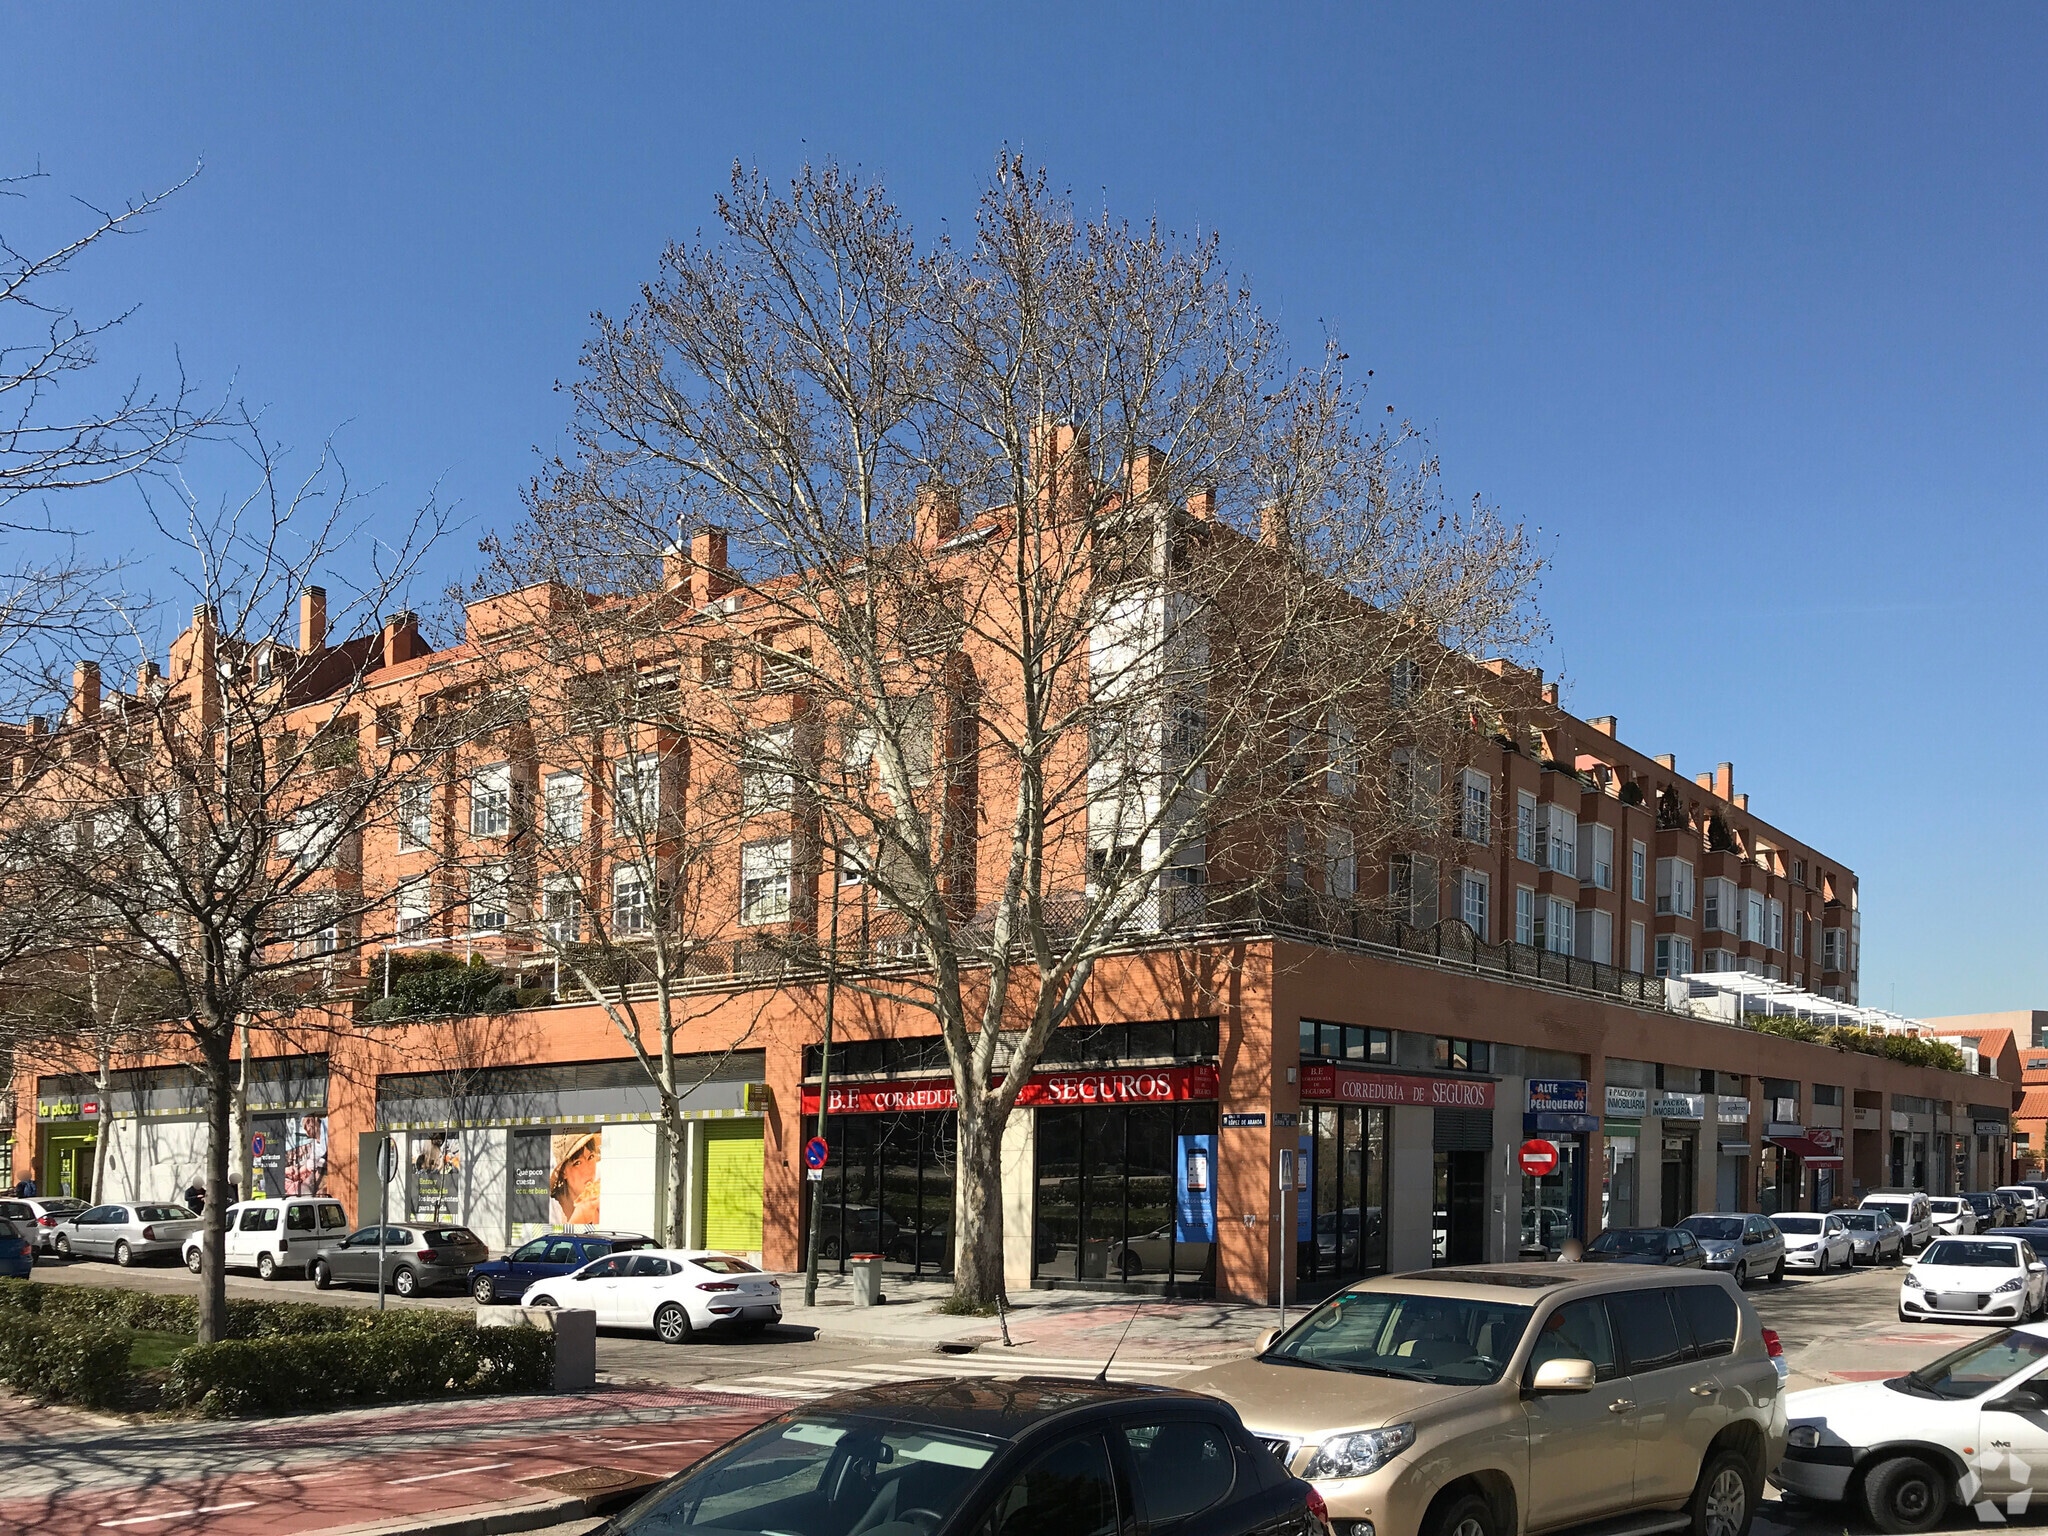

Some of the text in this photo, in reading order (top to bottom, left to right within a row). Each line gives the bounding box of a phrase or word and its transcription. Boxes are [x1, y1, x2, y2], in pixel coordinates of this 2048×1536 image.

[829, 1088, 860, 1109] B.F.
[1048, 1072, 1171, 1100] SEGUROS
[1342, 1081, 1485, 1106] CORREDURÍA DE SEGUROS
[1538, 1083, 1559, 1093] ALTE
[1613, 1088, 1637, 1098] PACEGO
[38, 1098, 79, 1120] la plaza
[1530, 1099, 1585, 1110] PELUQUEROS
[1607, 1098, 1646, 1111] INMOBILIARIA
[1653, 1106, 1691, 1117] INMOBILIARIA
[528, 1169, 543, 1177] poco
[418, 1205, 430, 1213] para
